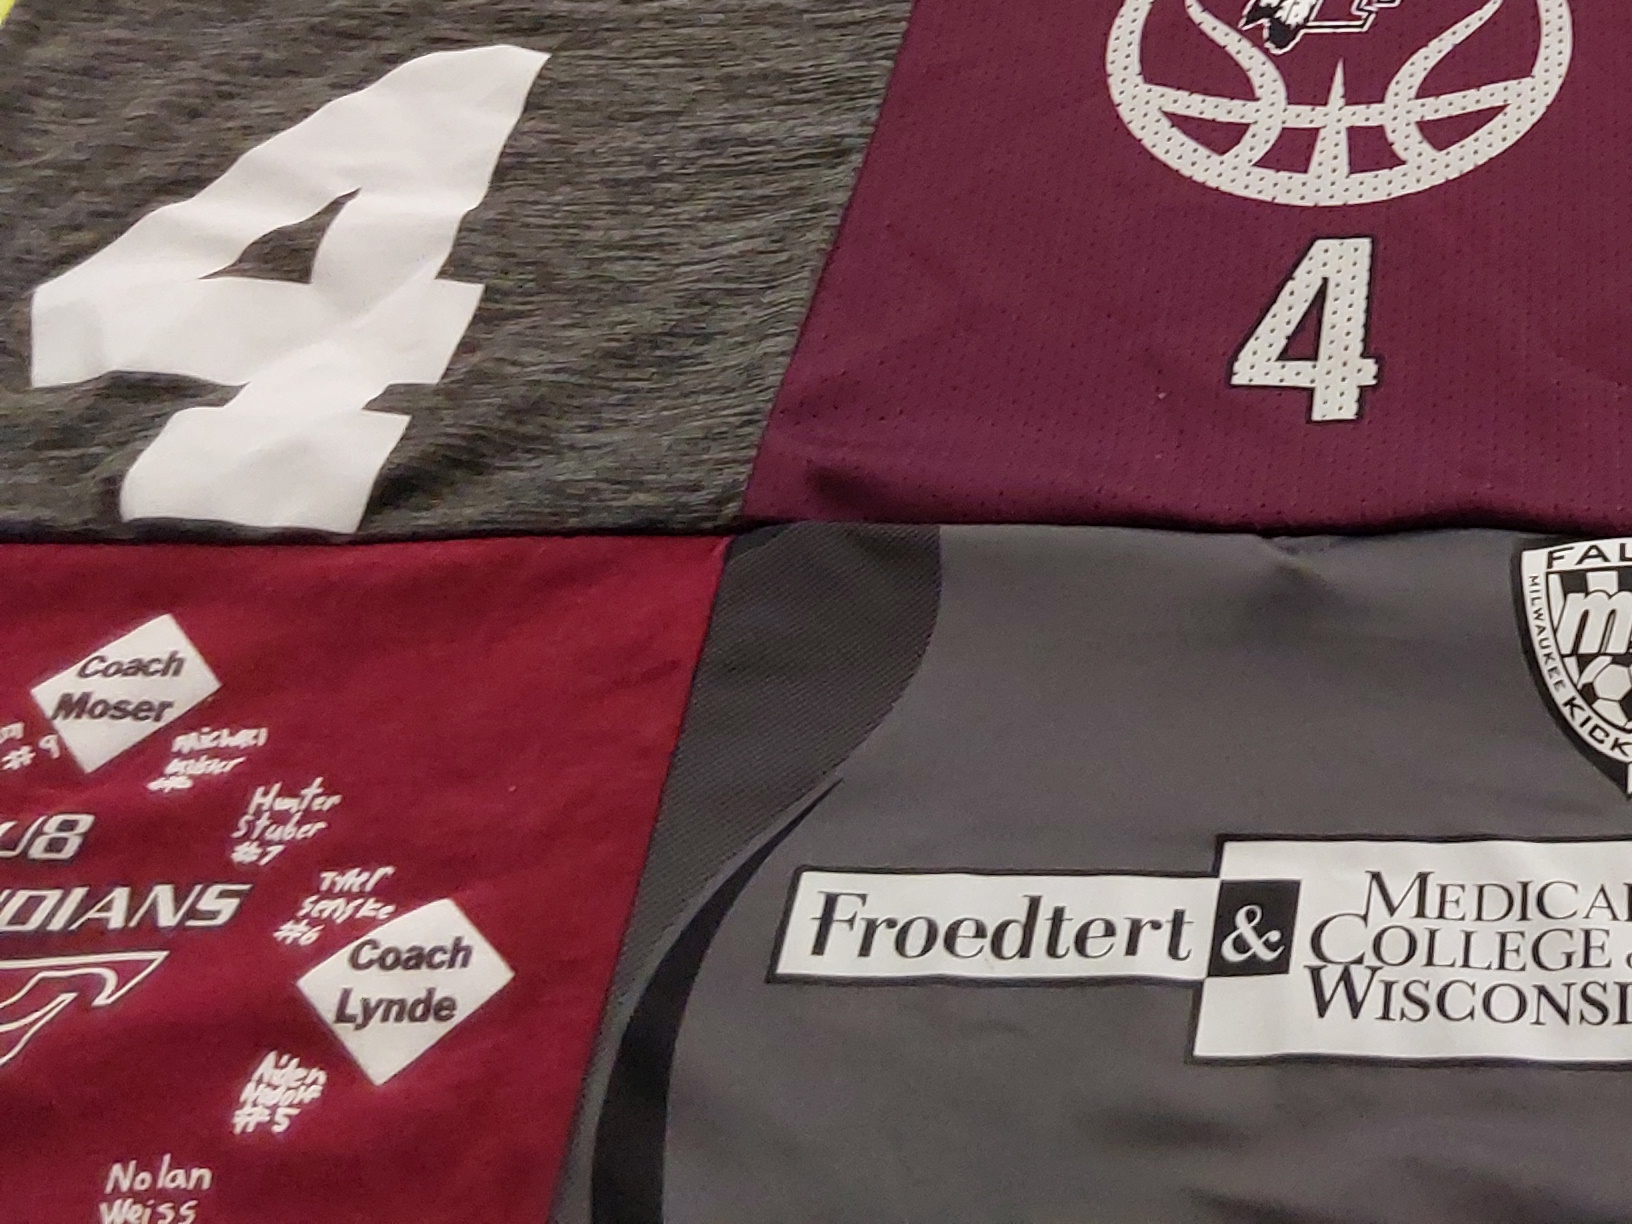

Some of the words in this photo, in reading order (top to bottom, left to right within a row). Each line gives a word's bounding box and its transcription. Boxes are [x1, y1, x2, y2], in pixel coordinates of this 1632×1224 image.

[30, 43, 552, 536] 4
[1226, 235, 1382, 423] 4
[1528, 574, 1569, 694] MILWAUKEE
[78, 649, 185, 681] Coach
[51, 691, 176, 723] Moser
[248, 776, 343, 814] Hunter
[231, 811, 329, 841] Stuber
[272, 918, 326, 947] #6
[809, 891, 1195, 963] Froedtert
[1219, 903, 1287, 964] &
[1309, 912, 1615, 971] COLLEGE
[349, 936, 473, 973] Coach
[332, 987, 459, 1030] Lynde
[232, 1102, 302, 1136] #5
[103, 1153, 213, 1195] Nolan
[98, 1198, 200, 1224] Weiss
